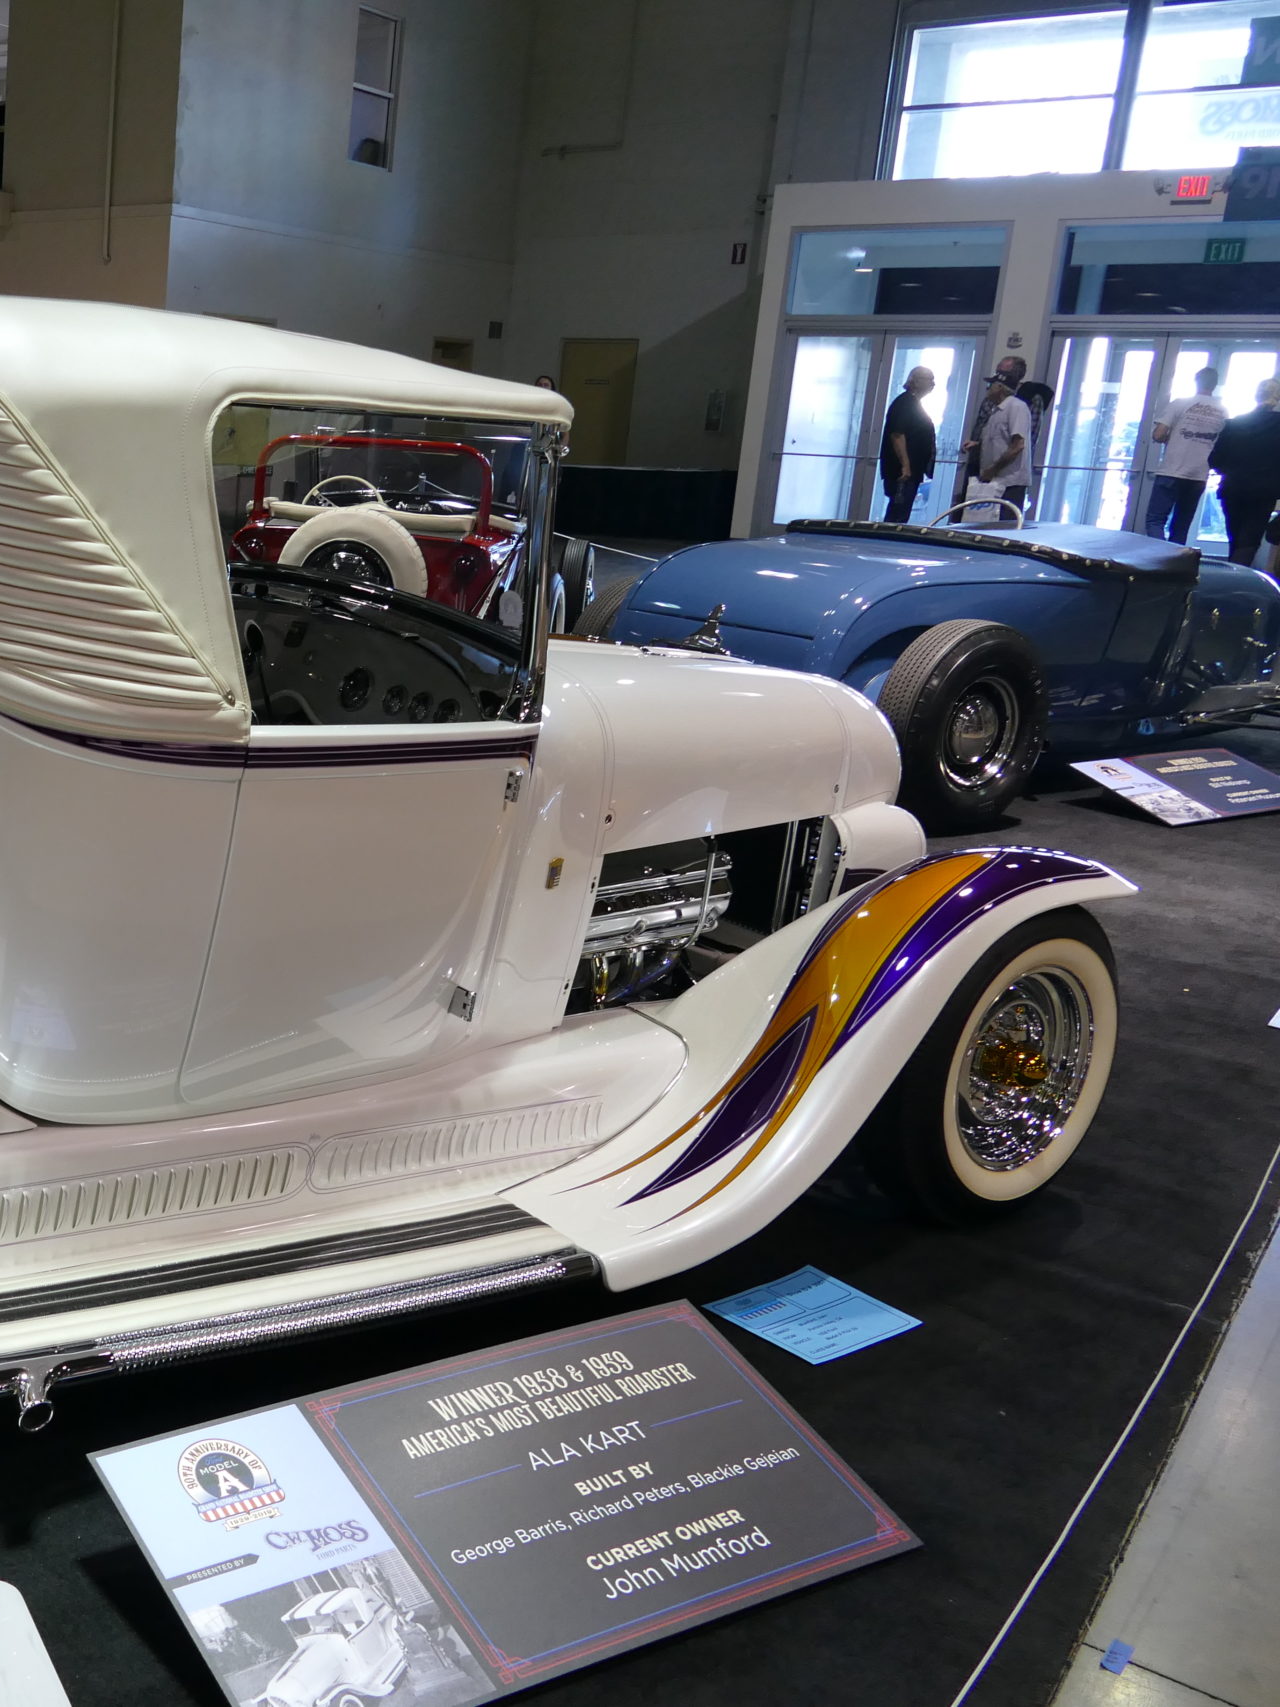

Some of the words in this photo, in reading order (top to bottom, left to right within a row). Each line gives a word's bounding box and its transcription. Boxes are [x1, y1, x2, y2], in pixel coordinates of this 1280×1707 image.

[1176, 175, 1211, 198] EXIT
[1209, 242, 1241, 261] EXIT
[427, 1380, 527, 1421] WINNER
[513, 1367, 568, 1398] 1958
[565, 1364, 584, 1383] &
[580, 1350, 634, 1379] 1959
[401, 1416, 495, 1459] AMERICA'S
[489, 1403, 540, 1433] MOST
[535, 1383, 623, 1419] BEAUTIFUL
[615, 1362, 697, 1397] ROADSTER
[185, 1441, 251, 1466] ANNIVERSARY
[528, 1442, 582, 1471] ALA
[578, 1420, 647, 1454] KART
[181, 1465, 199, 1491] 90TH
[199, 1459, 239, 1476] MODEL
[247, 1456, 263, 1473] OF
[573, 1469, 629, 1496] BUILT
[627, 1461, 656, 1481] BY
[214, 1468, 251, 1499] A
[450, 1535, 516, 1565] George
[514, 1519, 573, 1546] Barris,
[569, 1496, 635, 1528] Richard
[632, 1479, 691, 1507] Peters,
[686, 1462, 745, 1491] Blackie
[743, 1445, 800, 1472] Gejeian
[306, 1519, 369, 1553] MOSS
[585, 1531, 674, 1572] CURRENT
[674, 1508, 746, 1541] OWNER
[186, 1562, 228, 1582] PRESENTED
[226, 1557, 245, 1571] BY
[316, 1549, 336, 1561] FORD
[602, 1565, 664, 1601] John
[660, 1525, 772, 1577] Mumford
